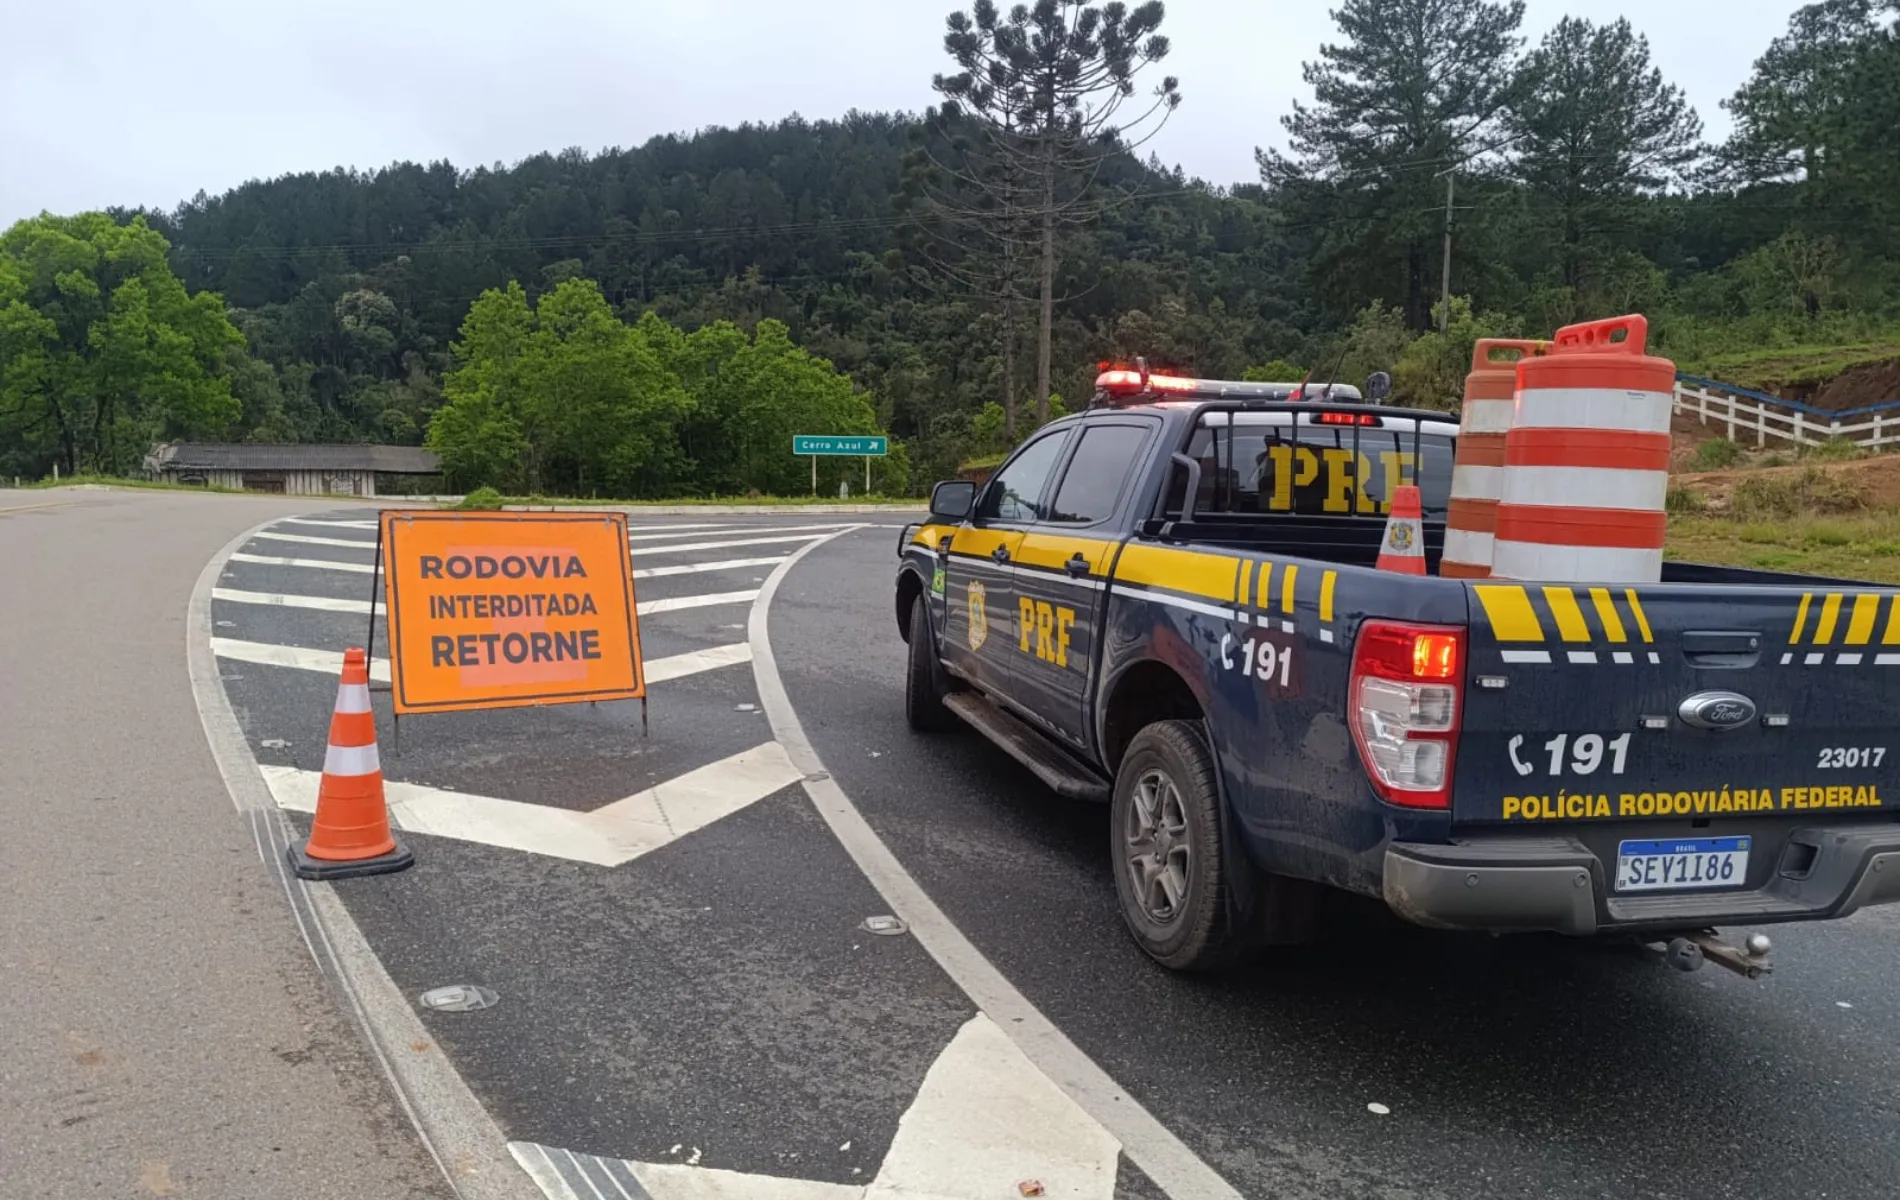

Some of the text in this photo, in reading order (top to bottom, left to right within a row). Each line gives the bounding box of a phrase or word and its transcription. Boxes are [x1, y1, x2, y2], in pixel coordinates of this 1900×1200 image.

[802, 441, 861, 449] Cerro Azul
[1269, 446, 1424, 513] PRF
[420, 555, 588, 579] RODOVIA
[429, 593, 598, 619] INTERDITADA
[431, 629, 601, 667] RETORNE
[1019, 596, 1075, 668] PRF
[1242, 638, 1292, 687] 191
[1711, 703, 1744, 720] Ford
[1544, 732, 1631, 775] 191
[1817, 747, 1886, 768] 23017
[1503, 784, 1882, 819] POLÍCIA RODOVIÁRIA FEDERAL
